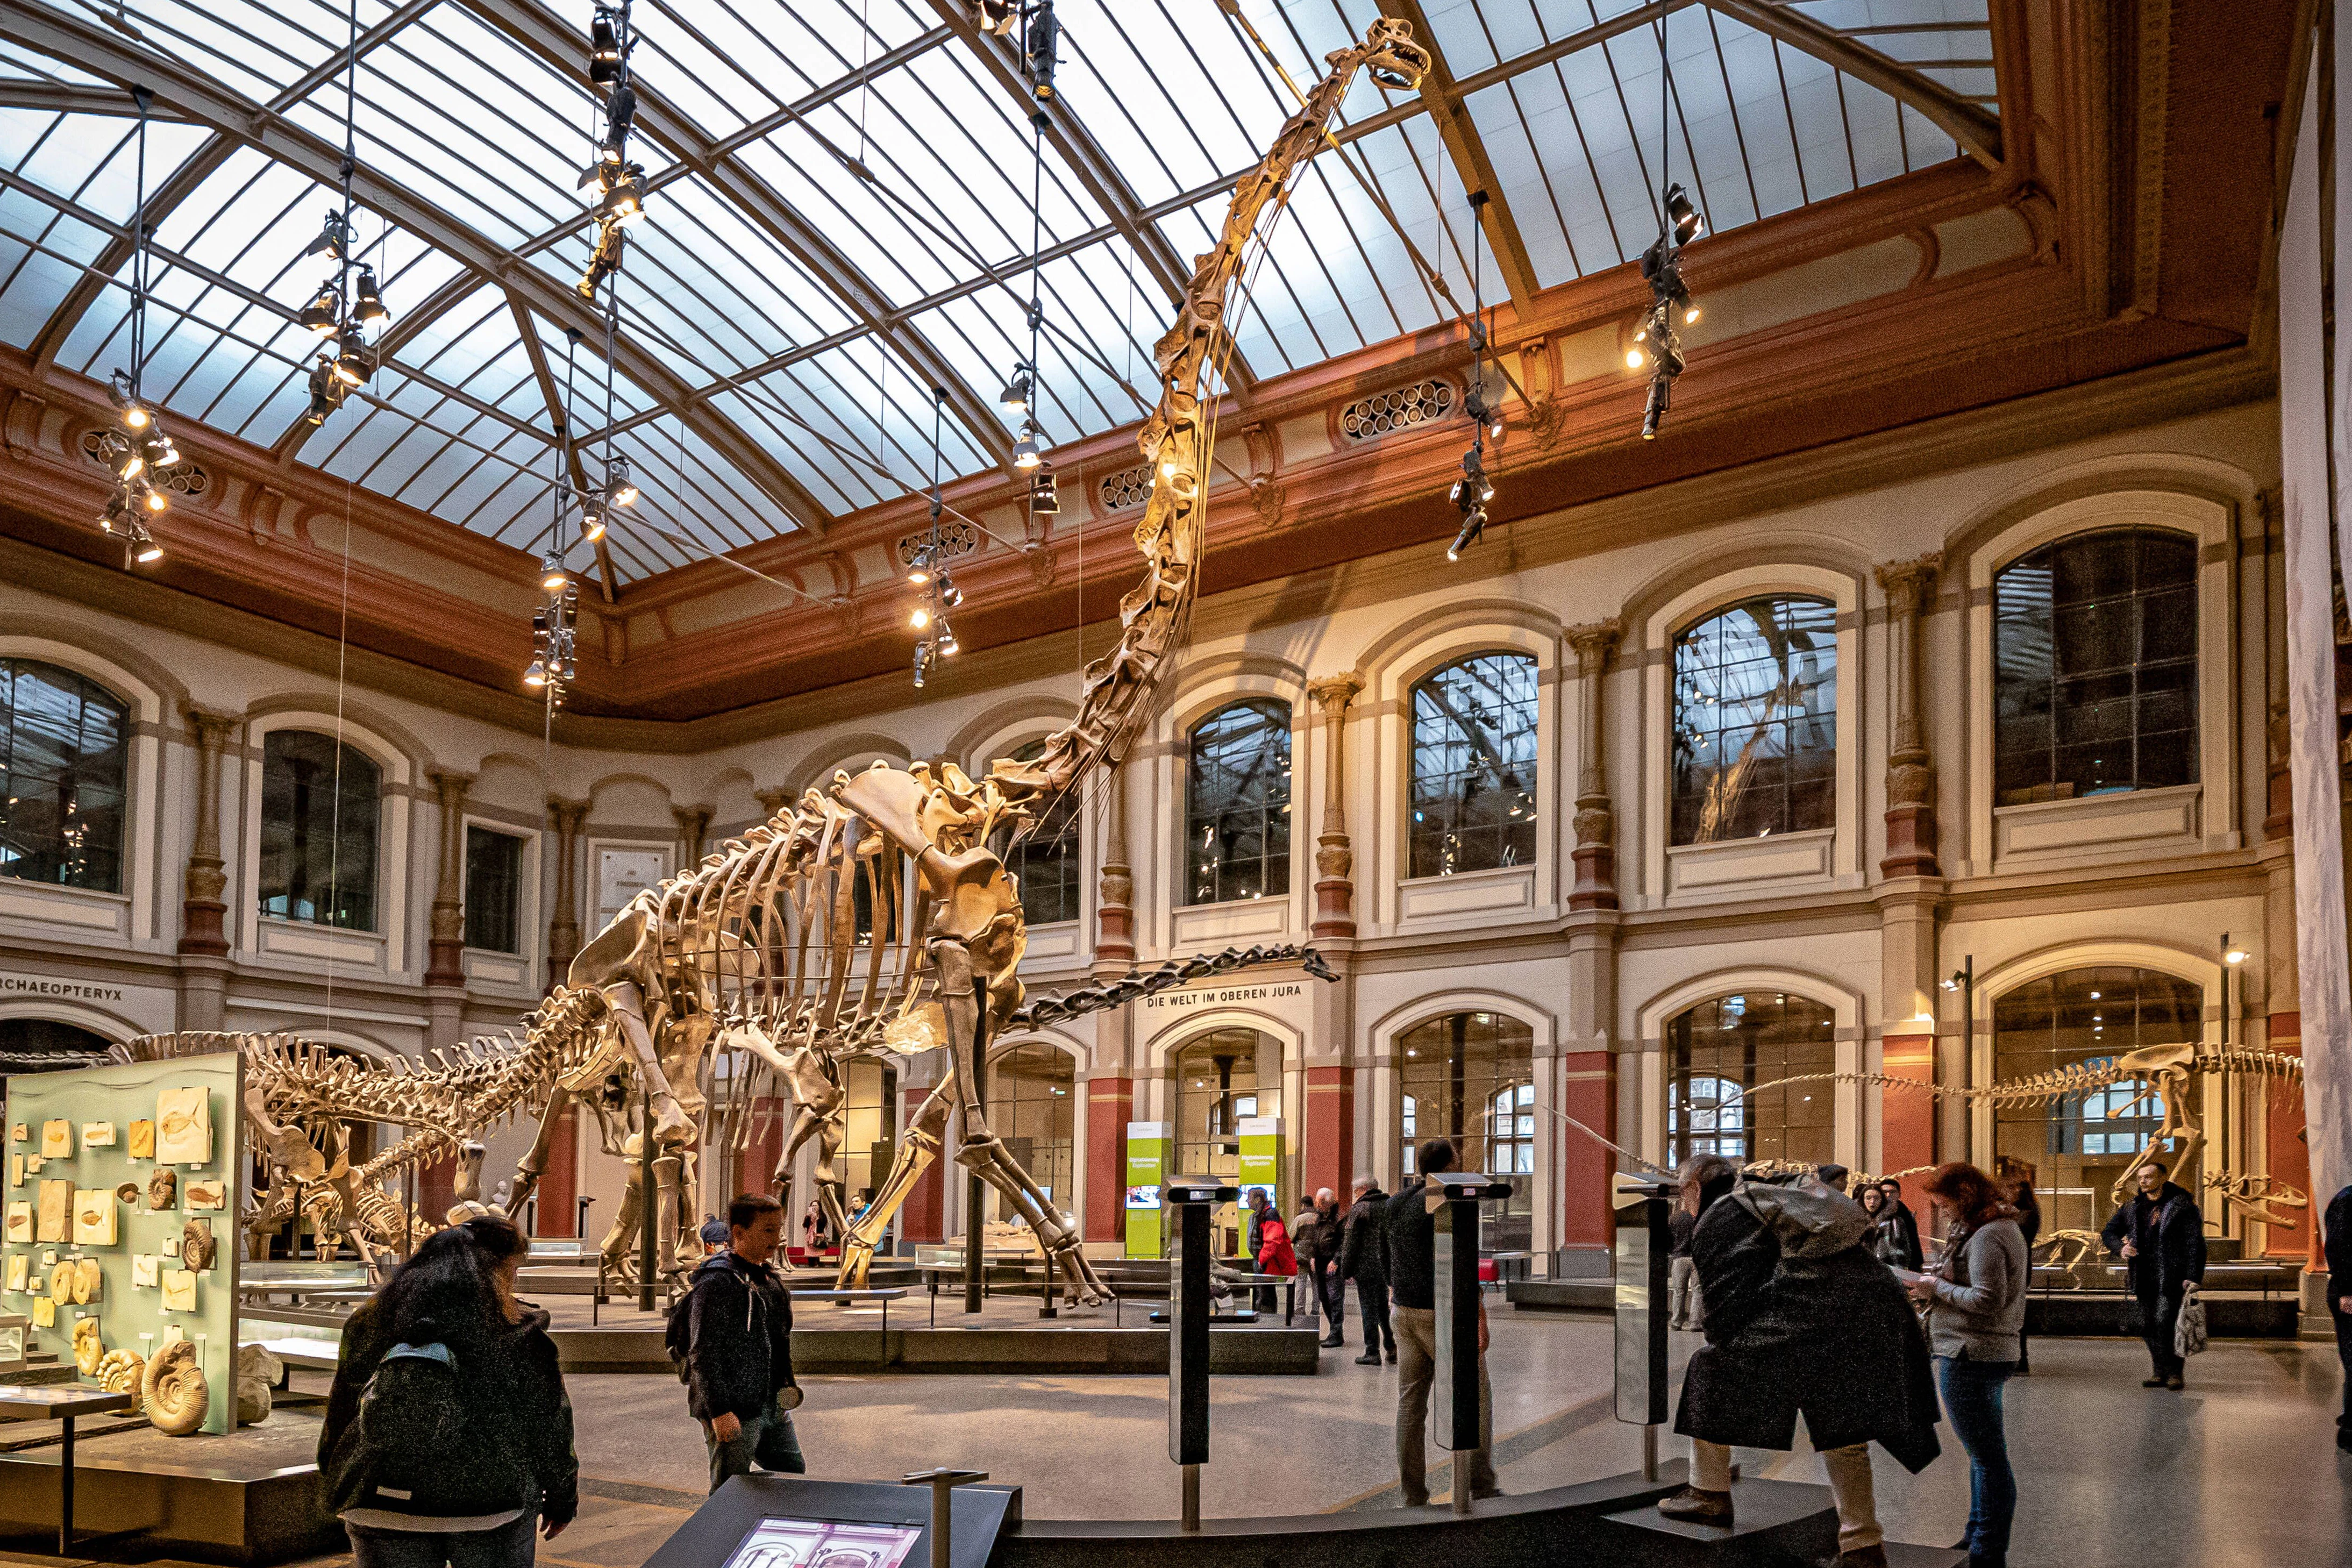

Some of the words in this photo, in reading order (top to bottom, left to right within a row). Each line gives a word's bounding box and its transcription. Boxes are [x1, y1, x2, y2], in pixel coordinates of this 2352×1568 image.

[0, 978, 121, 1001] CHAEOPTERYX
[1148, 997, 1165, 1008] DIE
[1170, 994, 1197, 1006] WELT
[1203, 993, 1215, 1003] IM
[1220, 988, 1267, 1002] OBEREN
[1272, 985, 1301, 997] JURA
